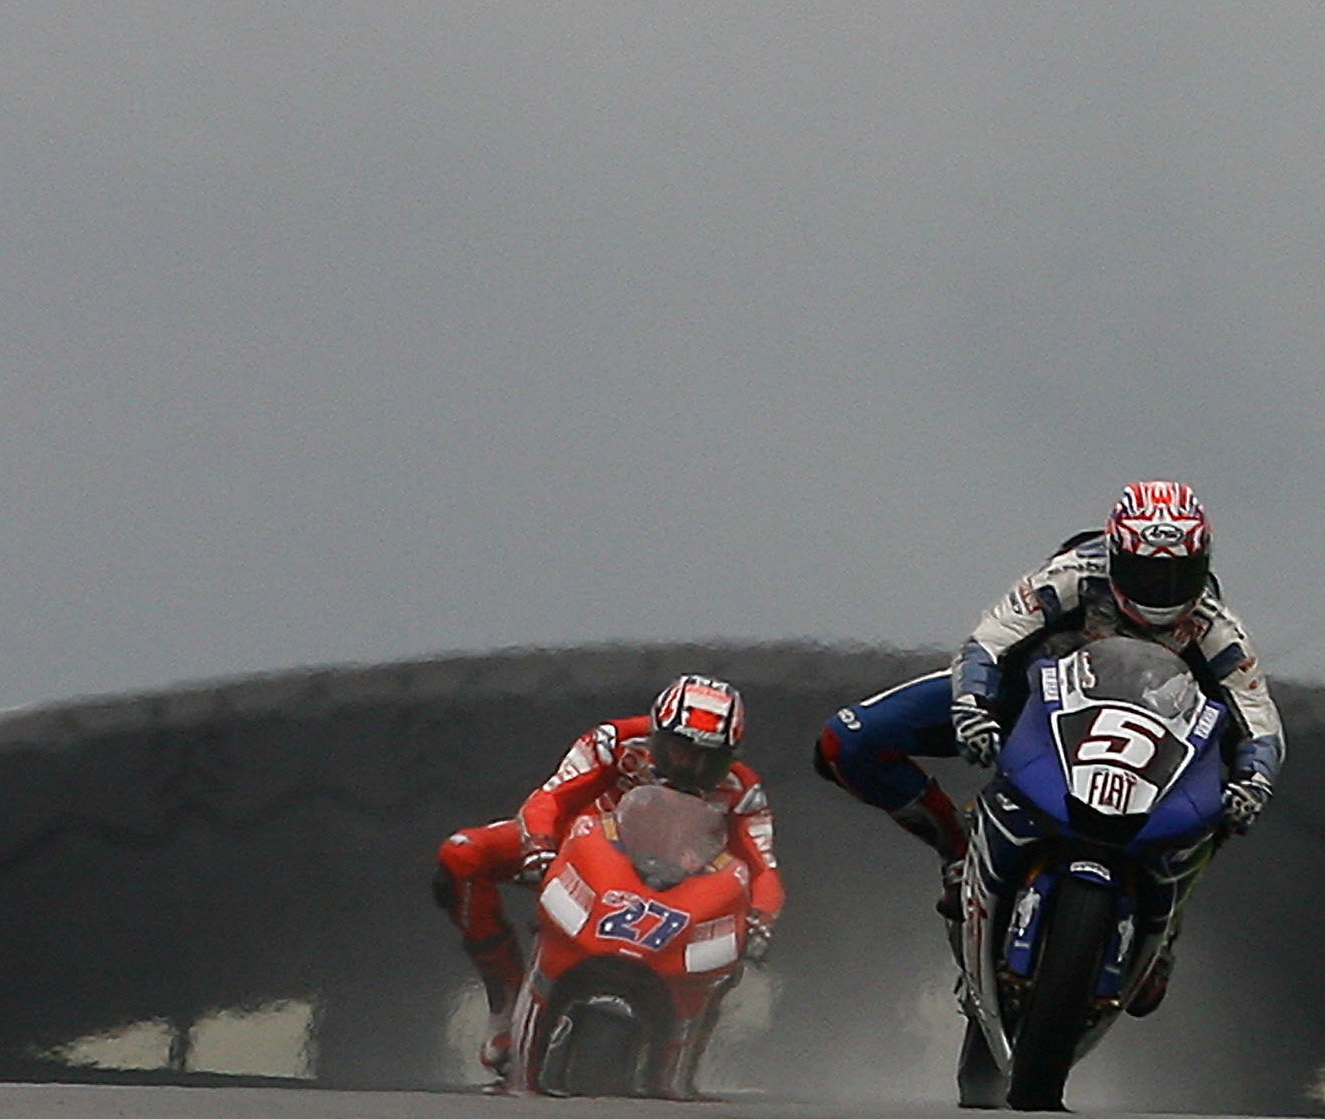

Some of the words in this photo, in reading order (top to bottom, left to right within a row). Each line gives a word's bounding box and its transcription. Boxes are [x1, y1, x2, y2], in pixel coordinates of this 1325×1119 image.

[1077, 707, 1166, 769] 5
[1088, 770, 1137, 815] FIAT
[596, 889, 690, 952] 27
